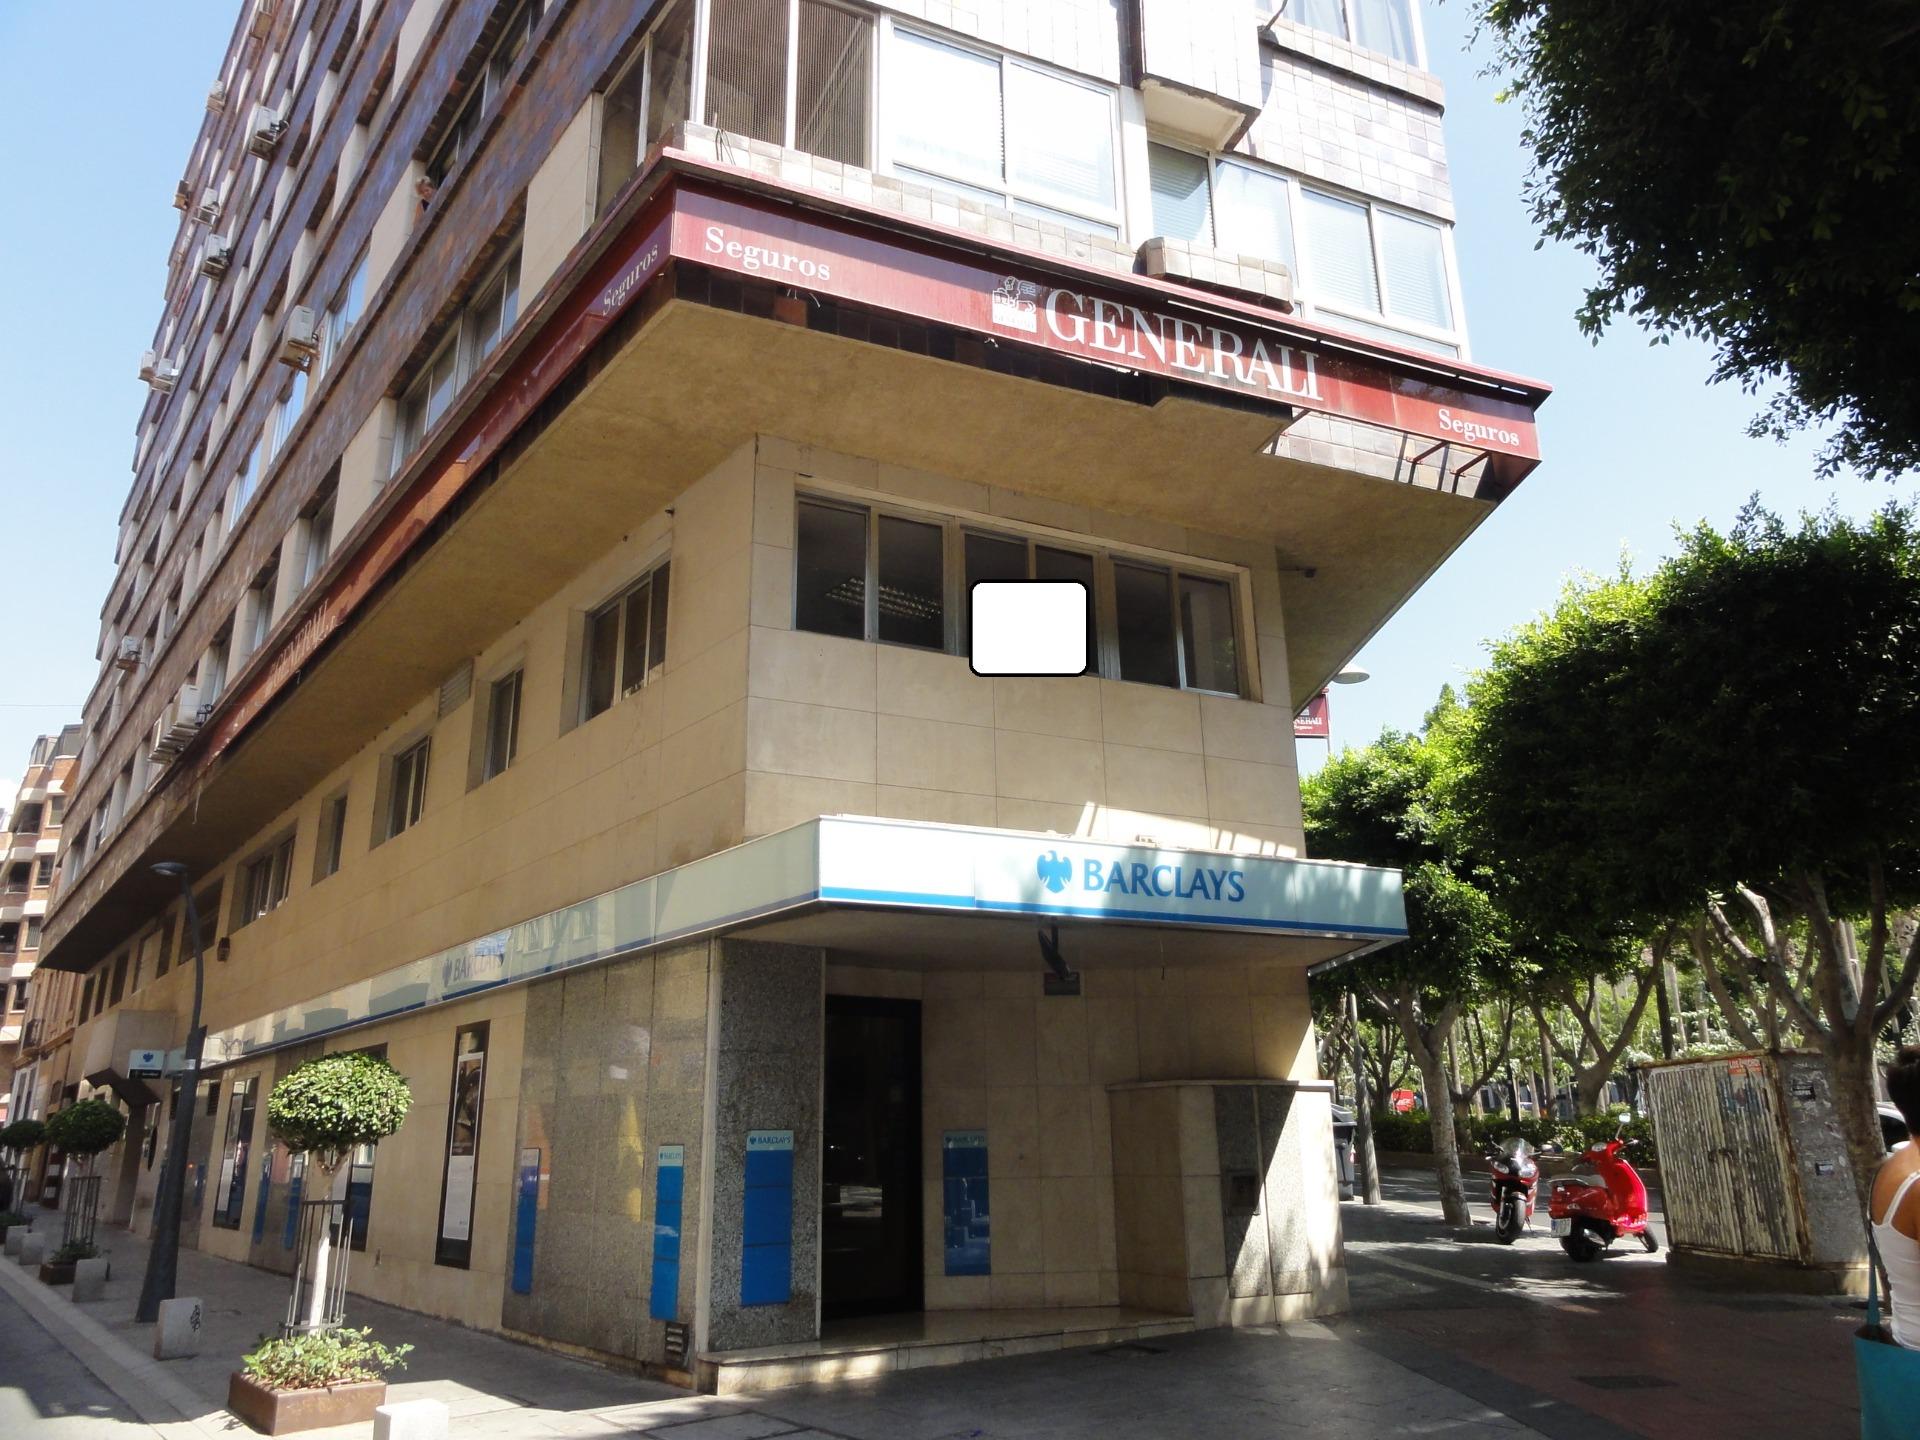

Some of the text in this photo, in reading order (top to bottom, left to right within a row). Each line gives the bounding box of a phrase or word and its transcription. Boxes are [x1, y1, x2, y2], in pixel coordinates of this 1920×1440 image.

[705, 227, 832, 281] Seguros
[602, 244, 659, 316] Seguros
[1045, 288, 1324, 401] GENERALI
[1438, 408, 1520, 446] Seguros
[1083, 858, 1246, 903] BARCLAYS
[757, 1135, 792, 1145] BARCLAYS
